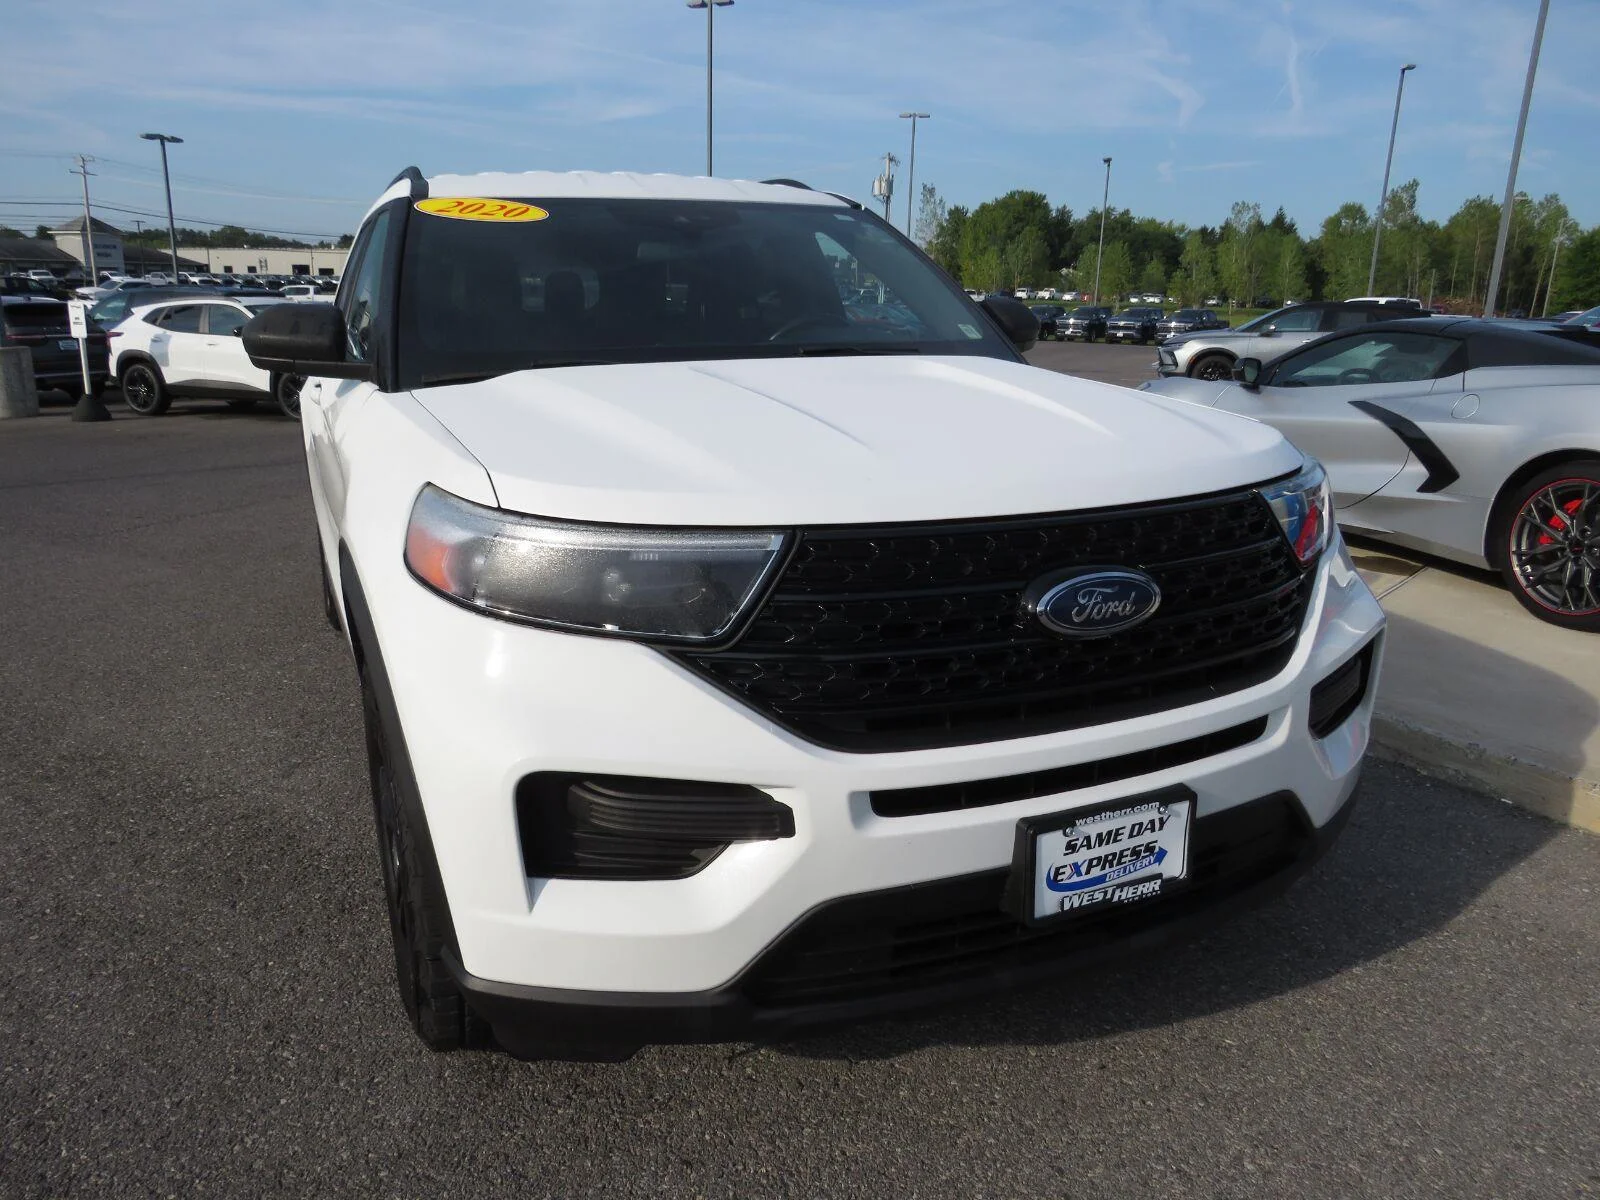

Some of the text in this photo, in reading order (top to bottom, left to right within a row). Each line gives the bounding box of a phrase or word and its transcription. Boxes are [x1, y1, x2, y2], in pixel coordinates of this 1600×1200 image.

[435, 200, 530, 218] 2020
[1071, 585, 1136, 623] Ford
[1075, 802, 1160, 826] westherr.com
[1063, 815, 1171, 856] SAME DAY
[1053, 840, 1158, 883] EXPRESS
[1105, 855, 1157, 882] DELIVERY
